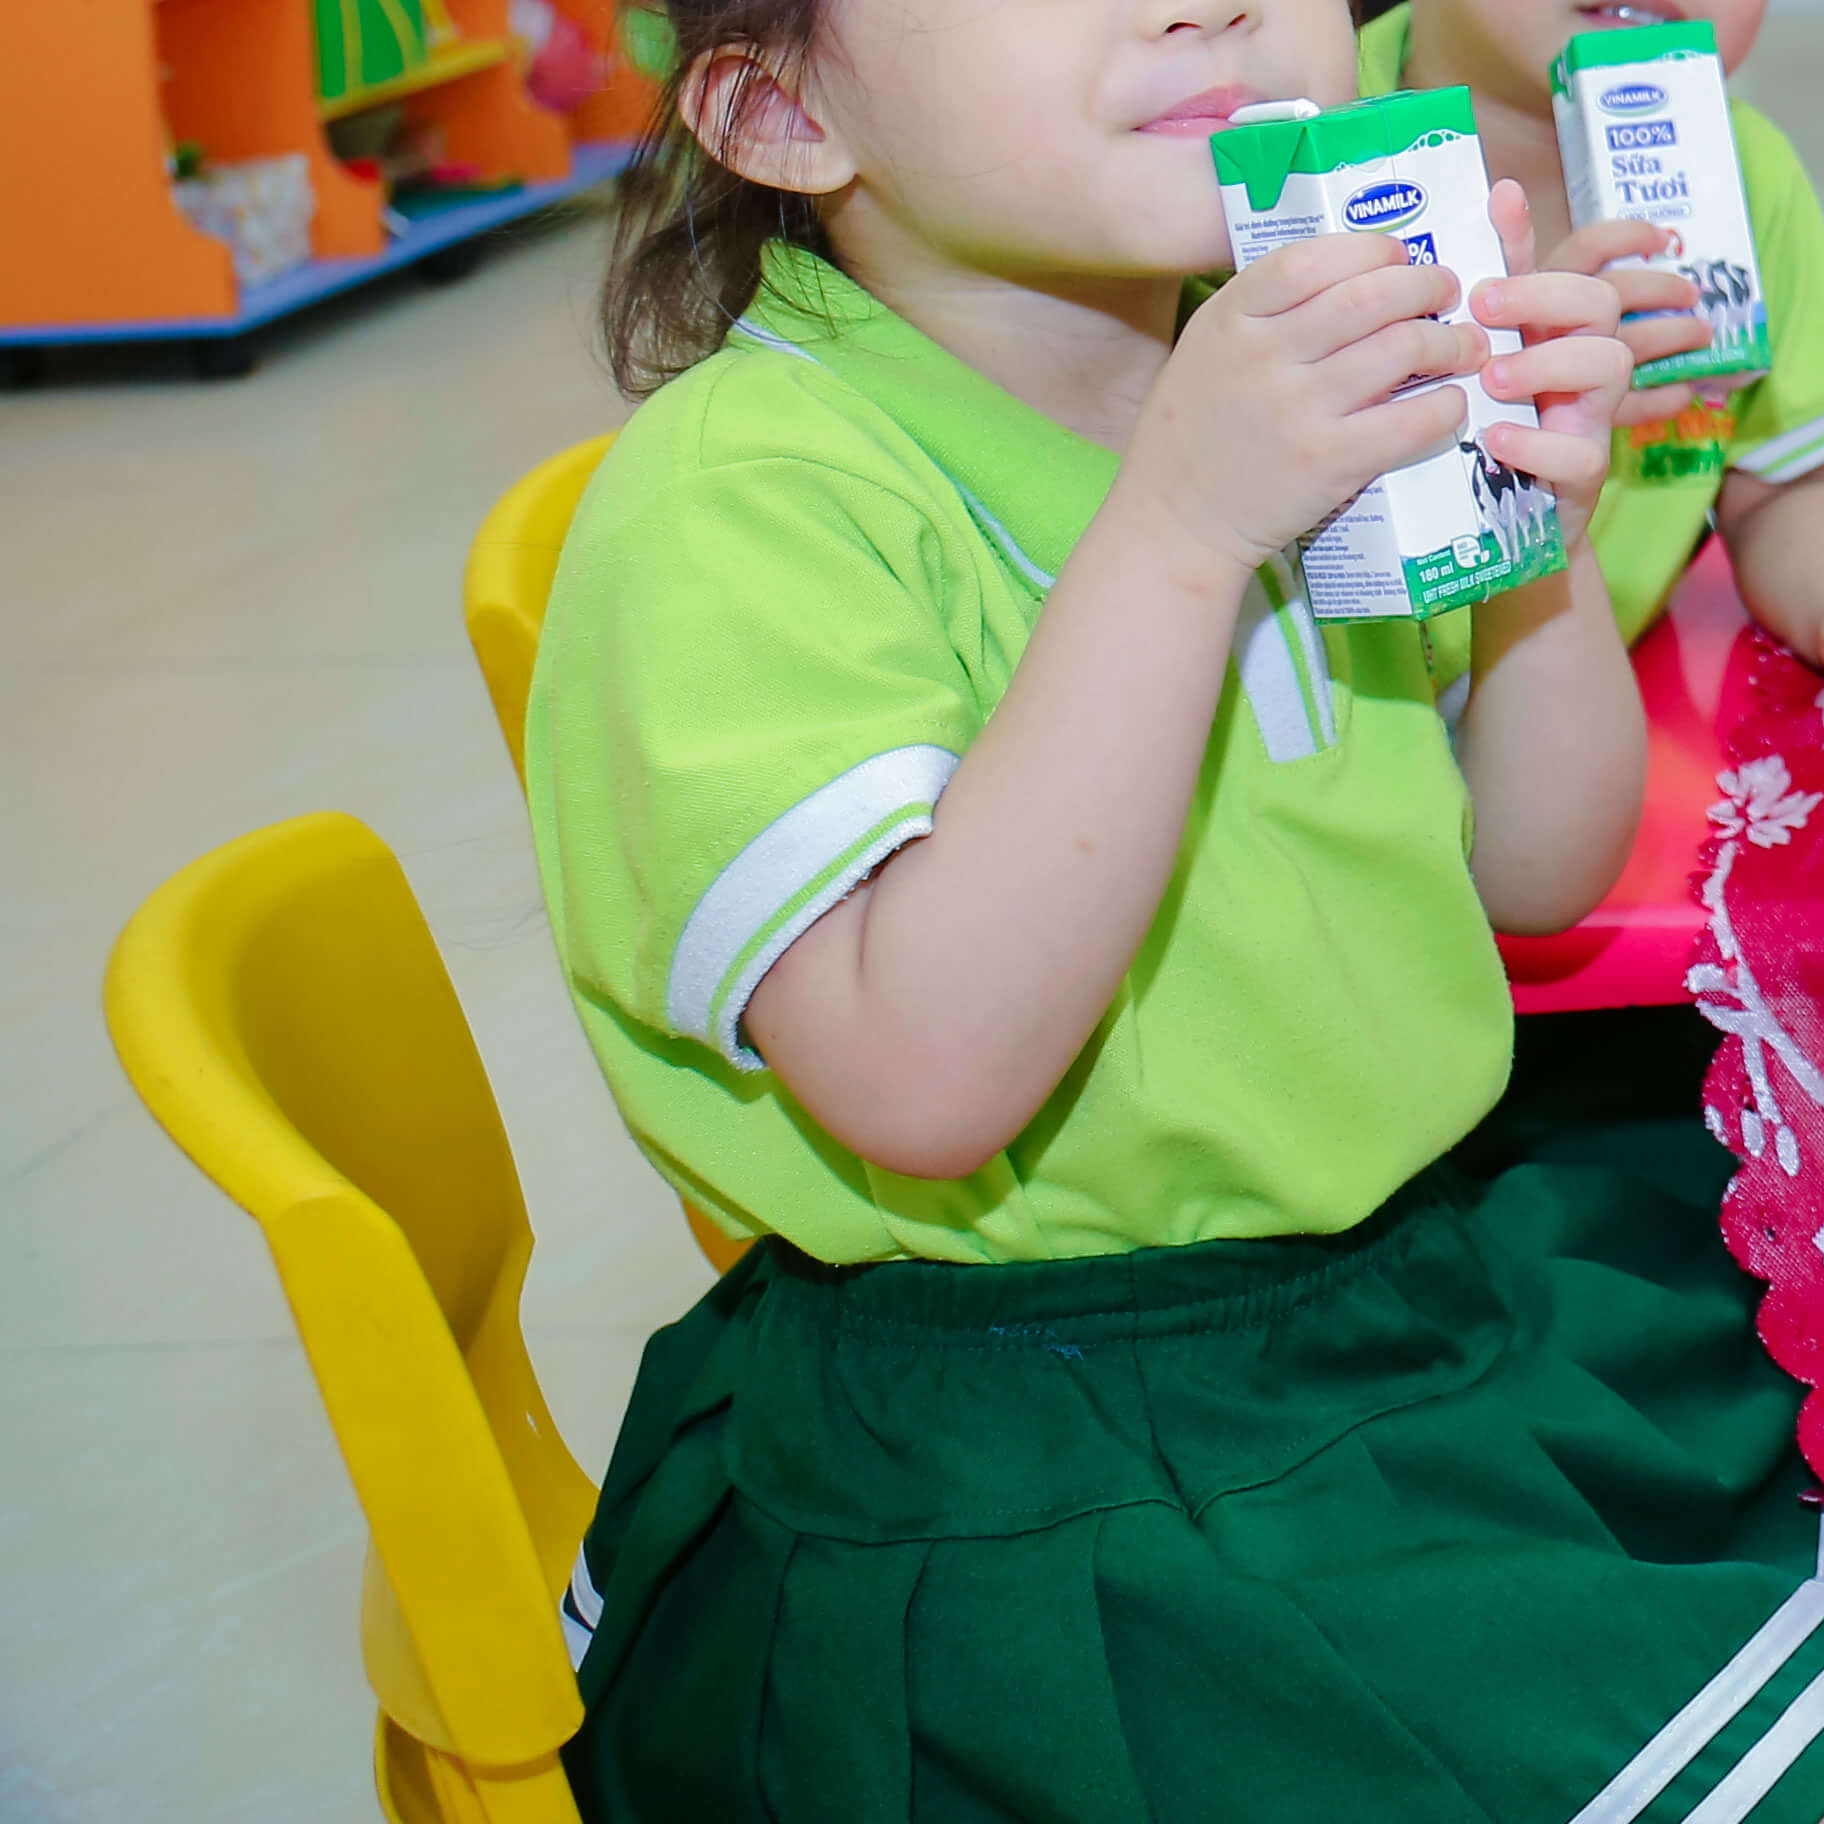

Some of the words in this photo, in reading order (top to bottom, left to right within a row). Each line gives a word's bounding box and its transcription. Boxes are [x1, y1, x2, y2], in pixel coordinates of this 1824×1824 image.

[1610, 126, 1672, 147] 100%
[1349, 189, 1419, 221] VINAMILK
[1441, 561, 1454, 577] ml
